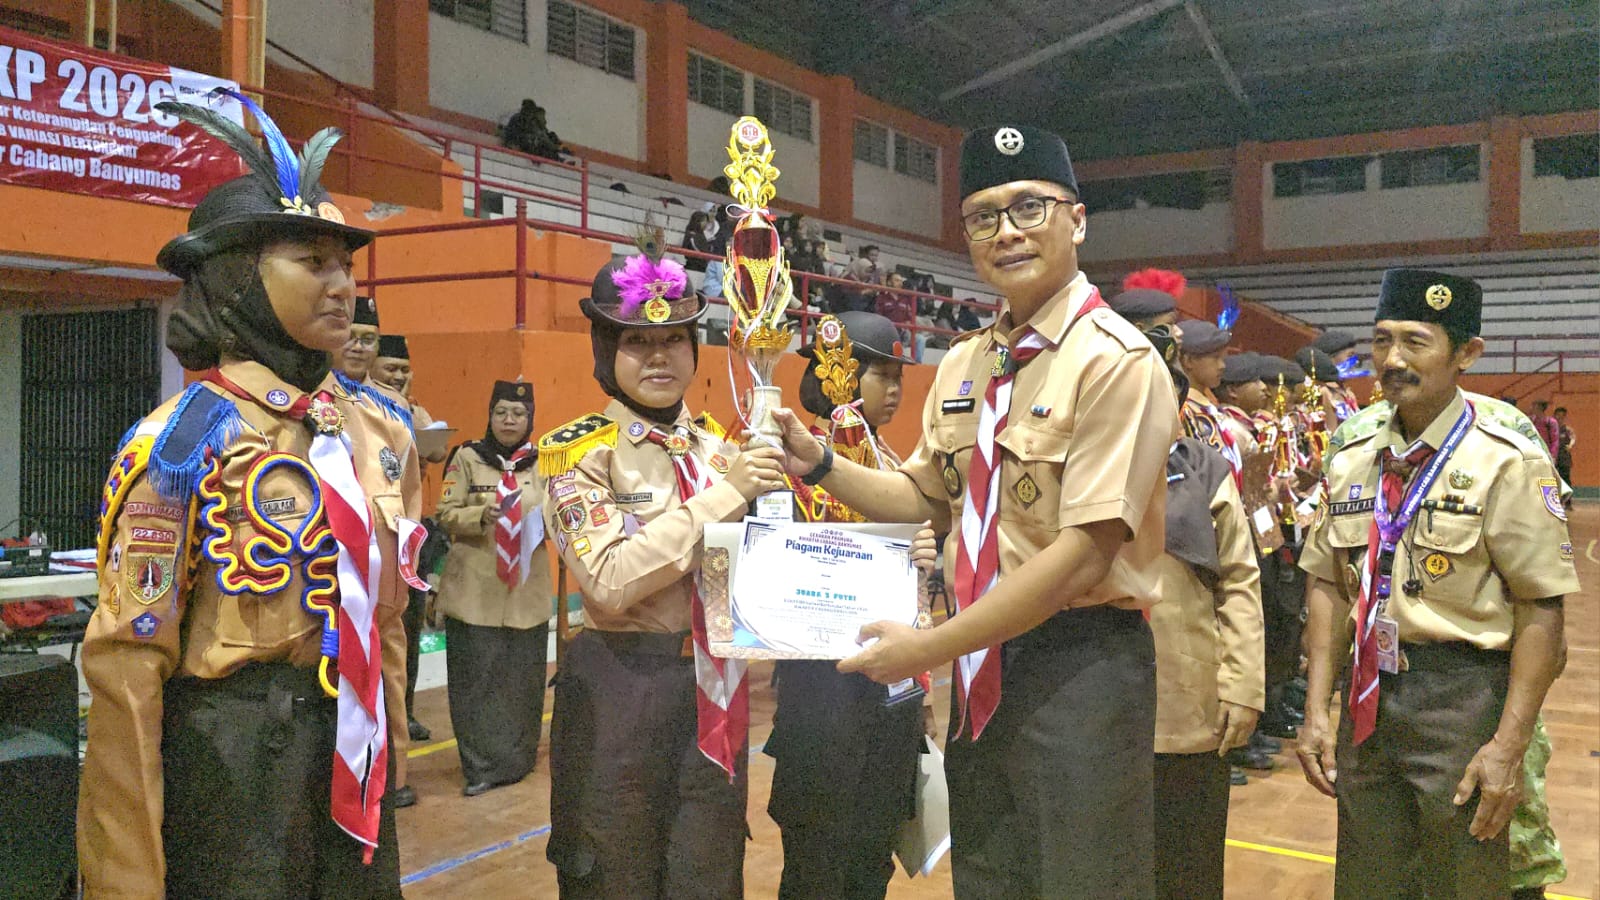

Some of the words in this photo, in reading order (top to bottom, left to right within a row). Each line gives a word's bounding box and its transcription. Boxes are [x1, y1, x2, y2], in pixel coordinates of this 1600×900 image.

[58, 59, 180, 128] 2026
[8, 125, 61, 146] VARIASI
[13, 105, 106, 134] Keterampilan
[109, 121, 183, 149] Penggalang
[10, 144, 86, 178] Cabang
[90, 157, 181, 191] Banyumas
[129, 504, 181, 519] BANYUMAS
[786, 538, 822, 554] Piagam
[823, 544, 873, 560] Kejuaraan
